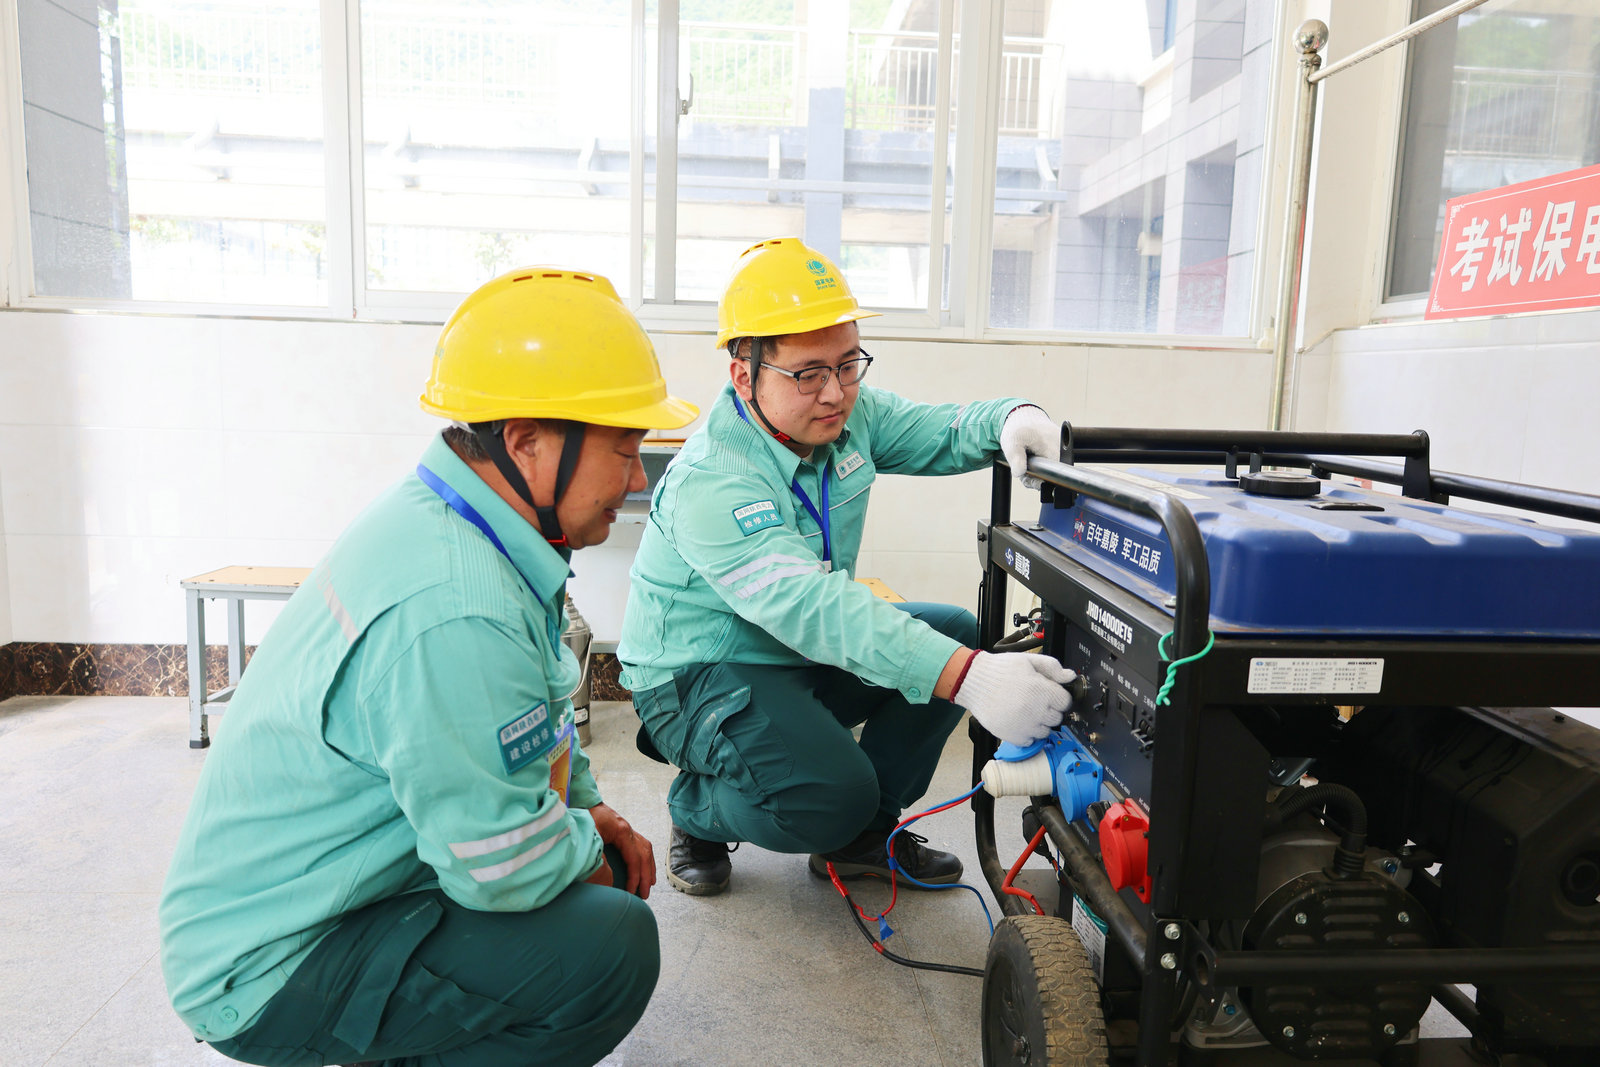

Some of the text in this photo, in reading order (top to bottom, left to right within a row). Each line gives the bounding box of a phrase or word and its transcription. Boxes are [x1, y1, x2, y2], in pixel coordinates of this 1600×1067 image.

[744, 513, 779, 529] 检修人员
[1086, 521, 1162, 575] 百年嘉陵 军工品质
[1086, 600, 1133, 645] JHD14000ETS
